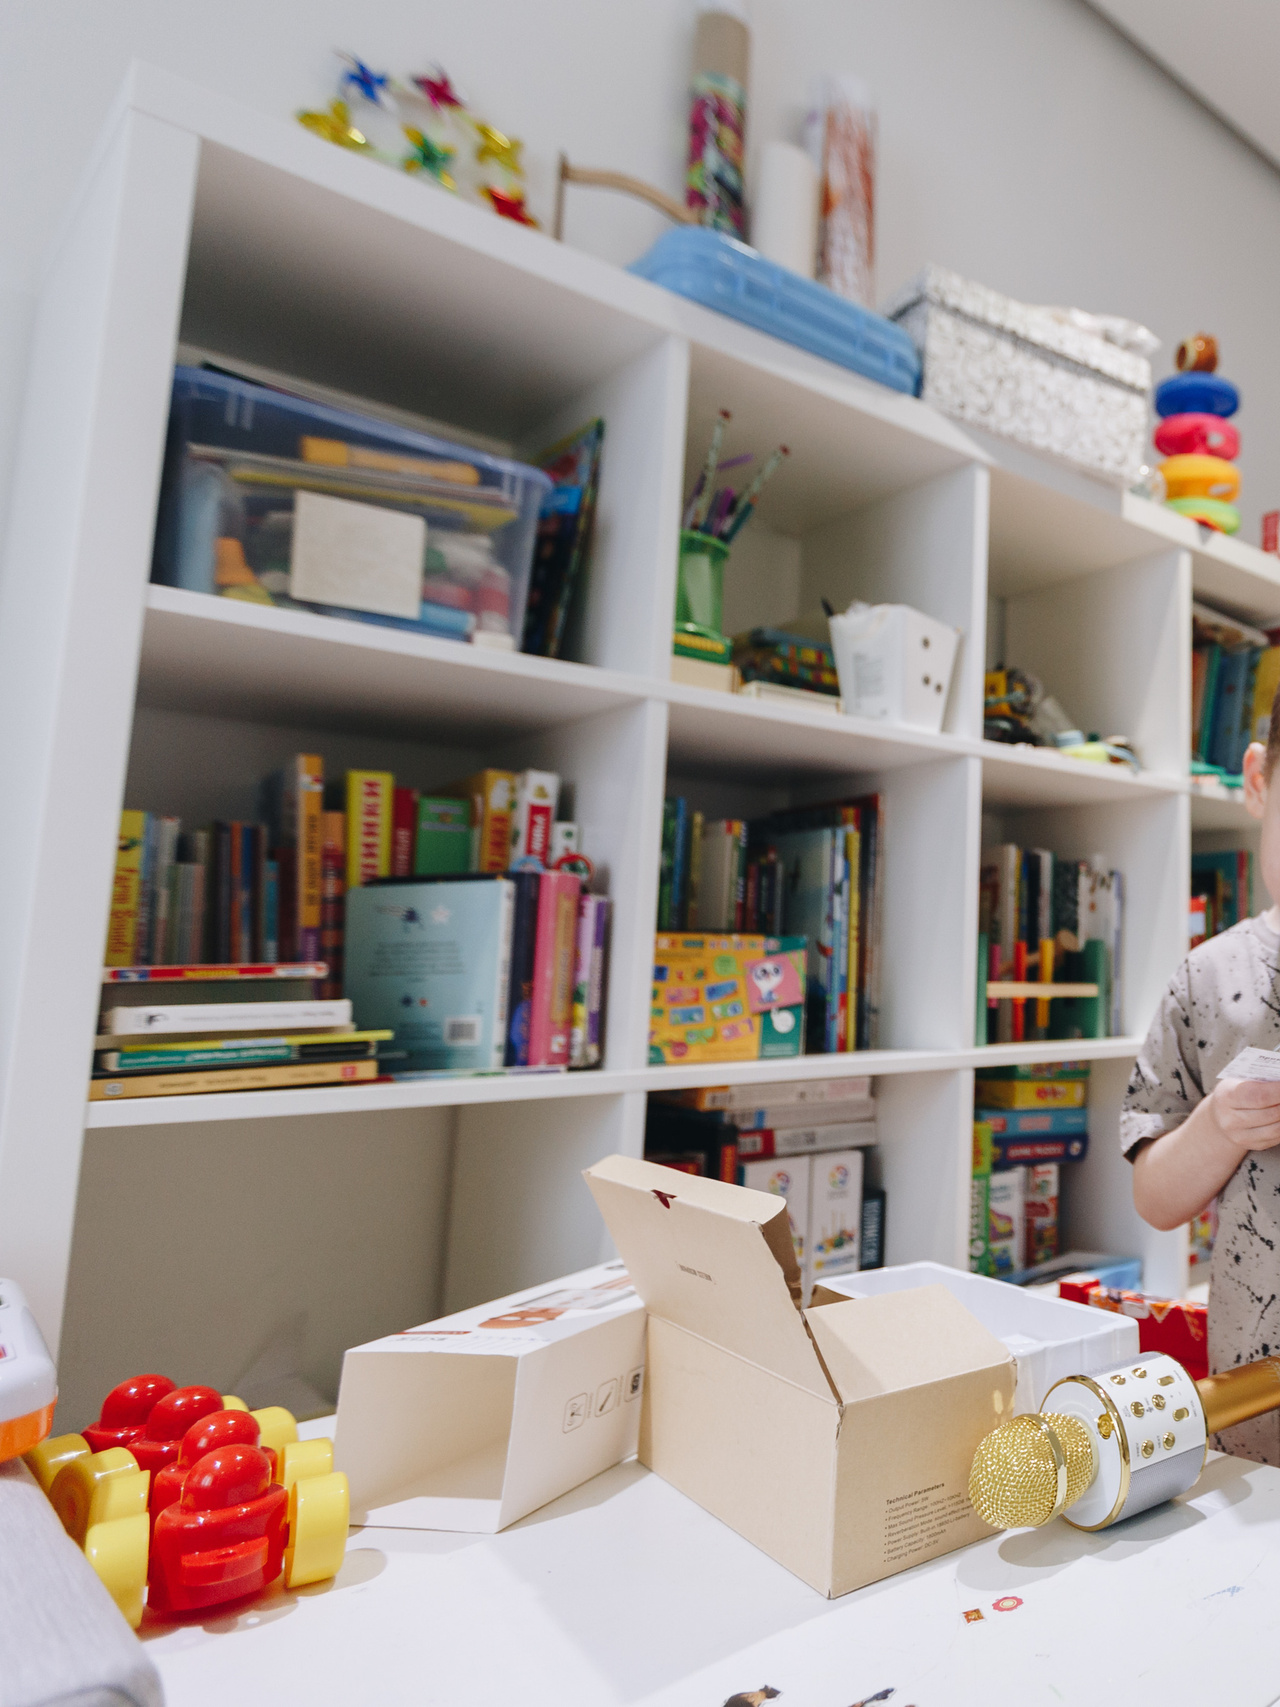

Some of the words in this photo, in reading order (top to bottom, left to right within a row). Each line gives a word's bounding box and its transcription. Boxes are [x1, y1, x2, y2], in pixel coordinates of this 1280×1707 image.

[886, 1493, 913, 1505] Technical
[914, 1483, 945, 1496] Parameters
[889, 1505, 904, 1513] Output
[888, 1511, 913, 1521] Frequency
[899, 1518, 913, 1526] Sound
[914, 1512, 933, 1520] Pressure
[887, 1552, 908, 1562] Charging
